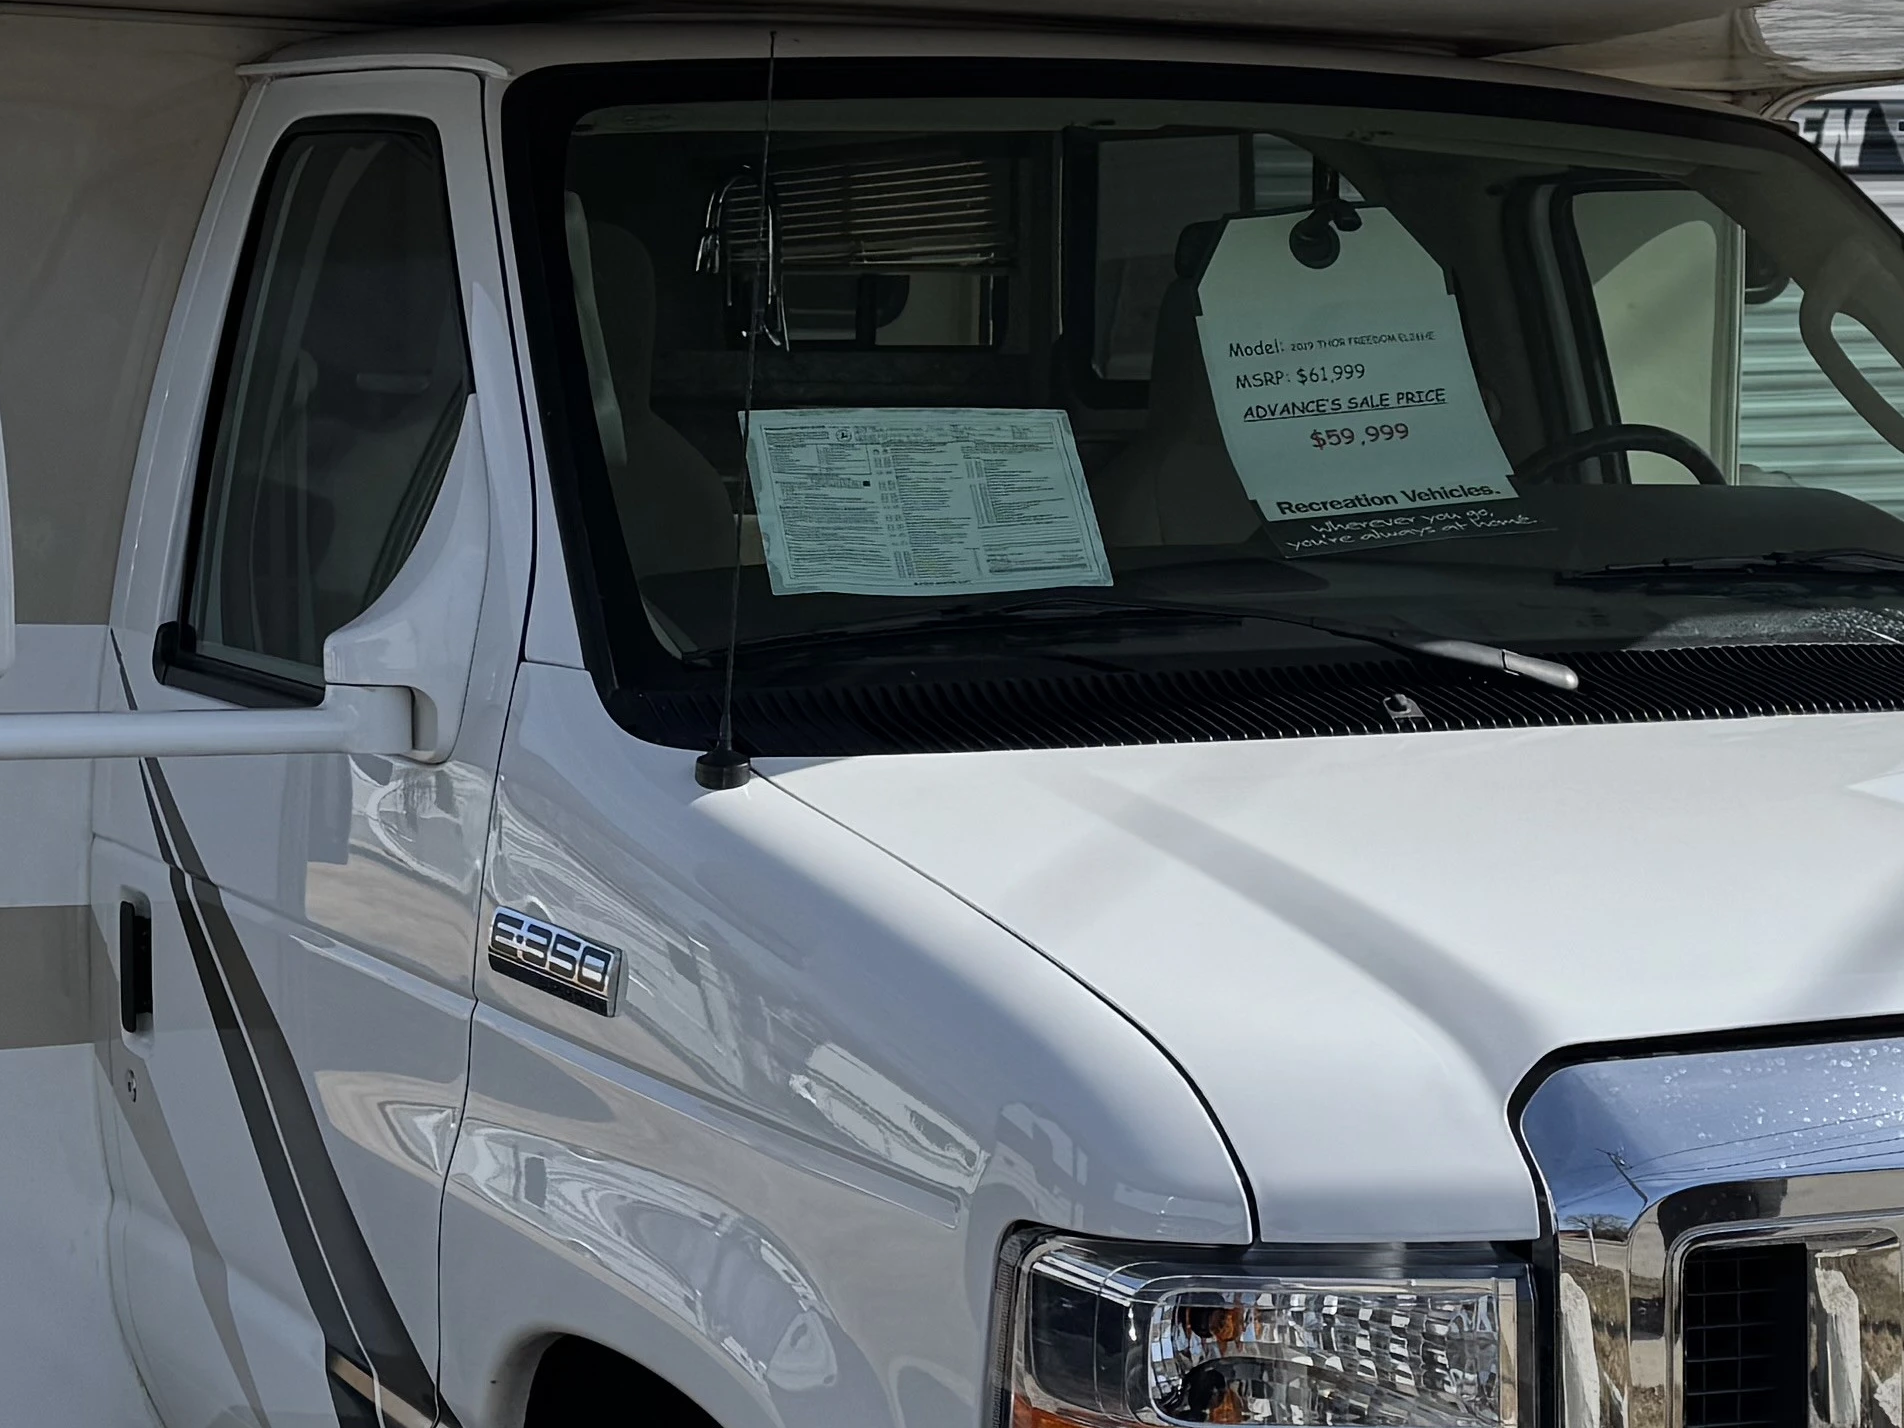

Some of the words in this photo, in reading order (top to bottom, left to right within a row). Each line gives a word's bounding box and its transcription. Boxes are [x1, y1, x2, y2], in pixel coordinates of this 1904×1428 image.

[1228, 338, 1285, 358] Model:
[1236, 370, 1291, 389] MSRP:
[1296, 363, 1366, 386] $61,999
[1244, 397, 1343, 420] ADVANCE'S
[1346, 392, 1391, 410] SALE
[1396, 387, 1447, 405] PRICE
[1276, 492, 1399, 515] Recreation
[1401, 483, 1501, 503] Vehicles.
[1421, 511, 1463, 524] you
[1465, 507, 1494, 521] go,
[1285, 533, 1356, 552] you're
[1360, 525, 1437, 541] always
[1441, 521, 1467, 533] at
